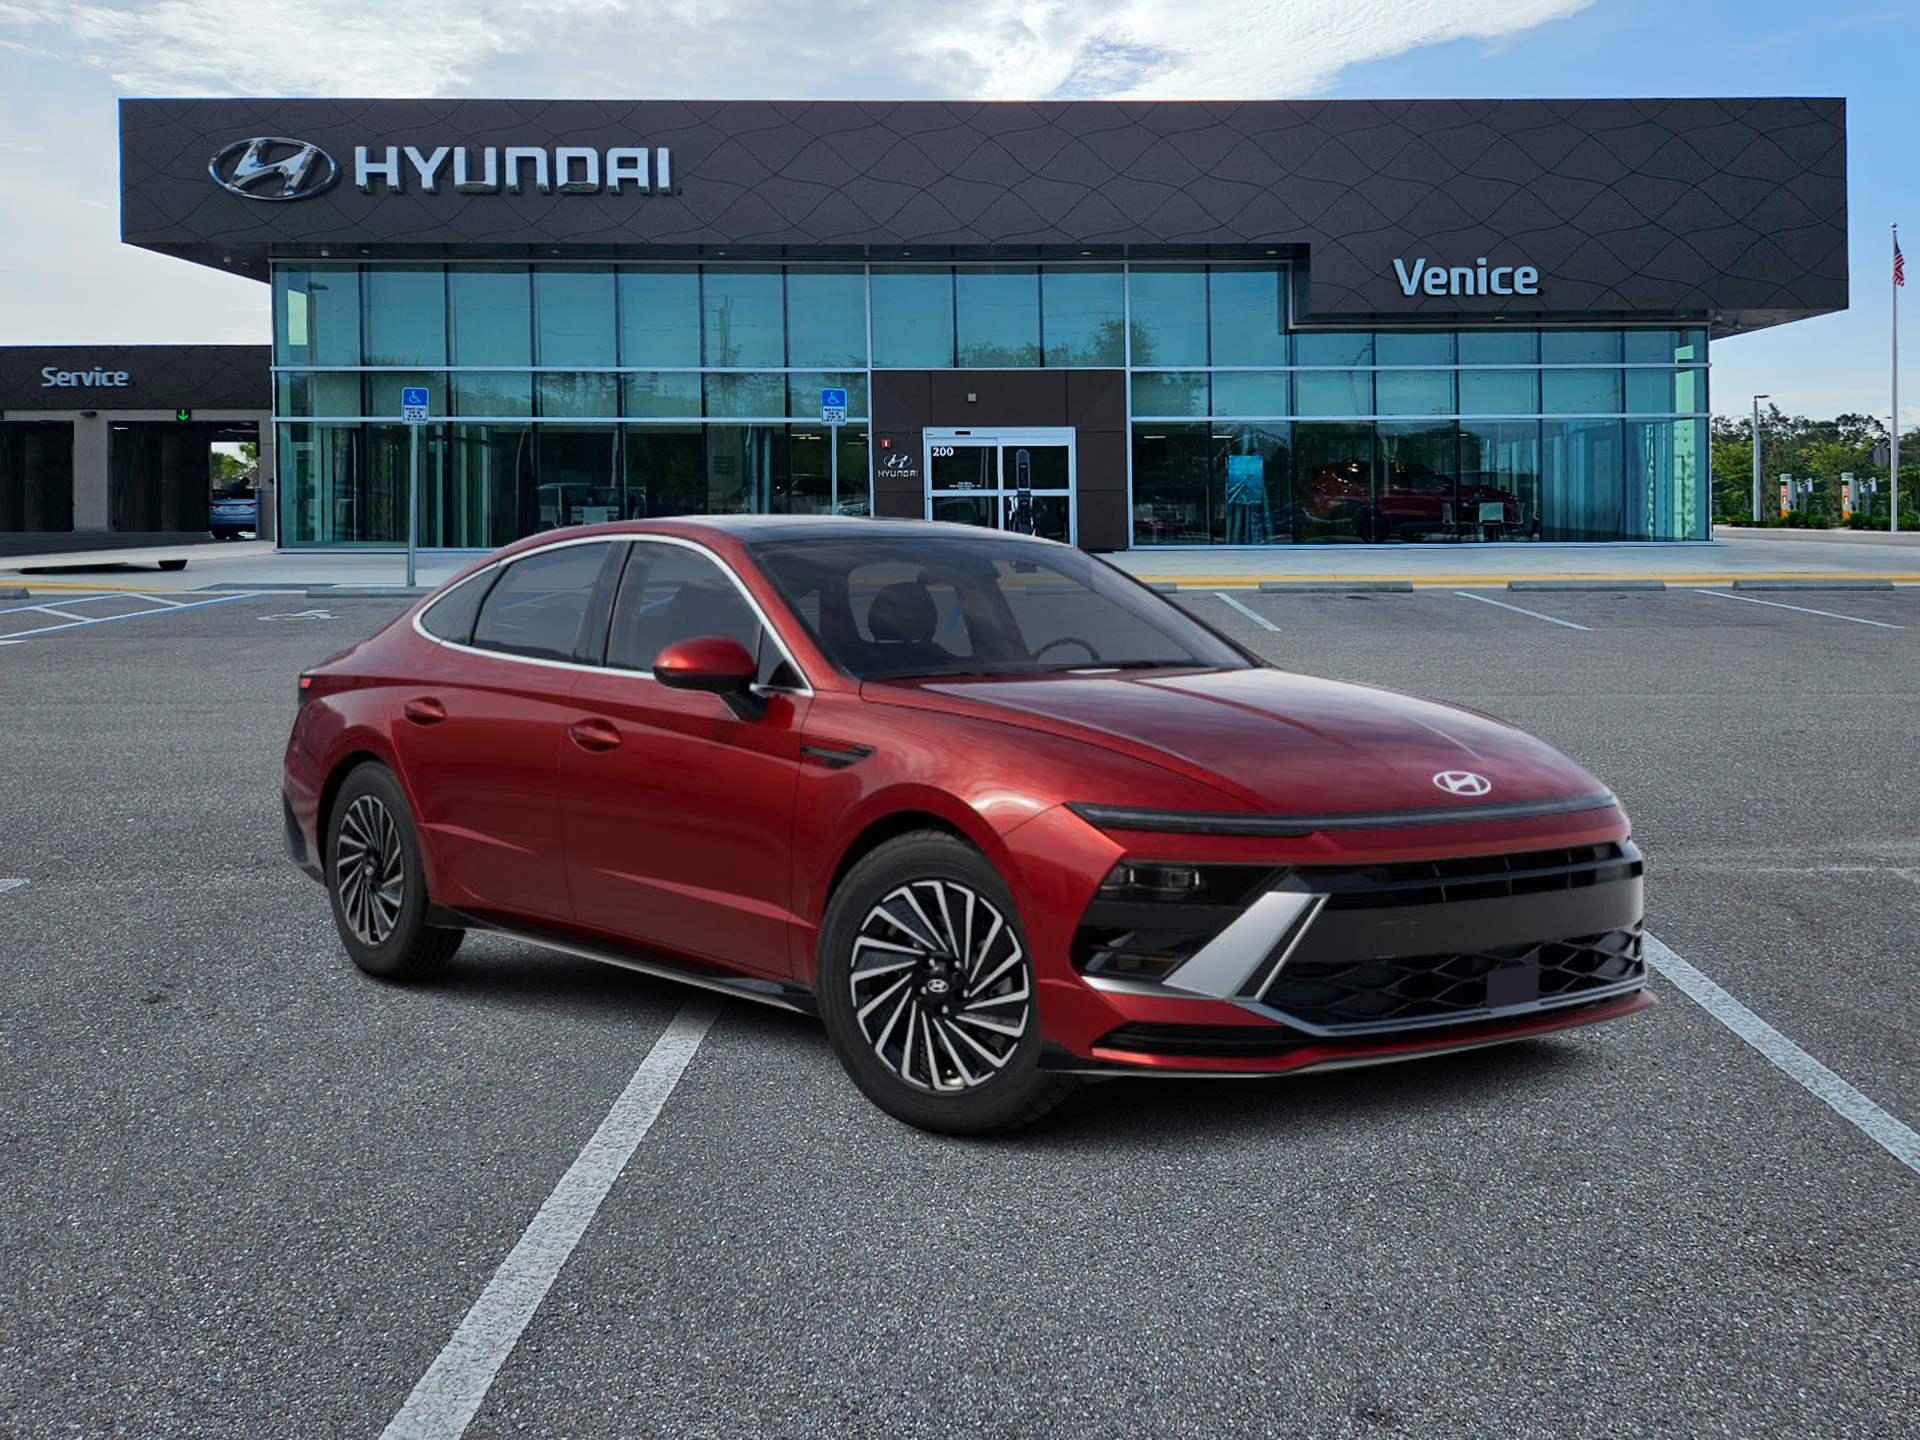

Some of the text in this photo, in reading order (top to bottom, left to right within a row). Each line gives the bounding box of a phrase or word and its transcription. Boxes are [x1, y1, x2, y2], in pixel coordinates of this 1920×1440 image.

[355, 147, 670, 193] HYUNDAI
[1393, 257, 1538, 296] Venice
[42, 366, 129, 387] Service
[932, 446, 954, 457] 200
[877, 470, 919, 478] HYUNDAI
